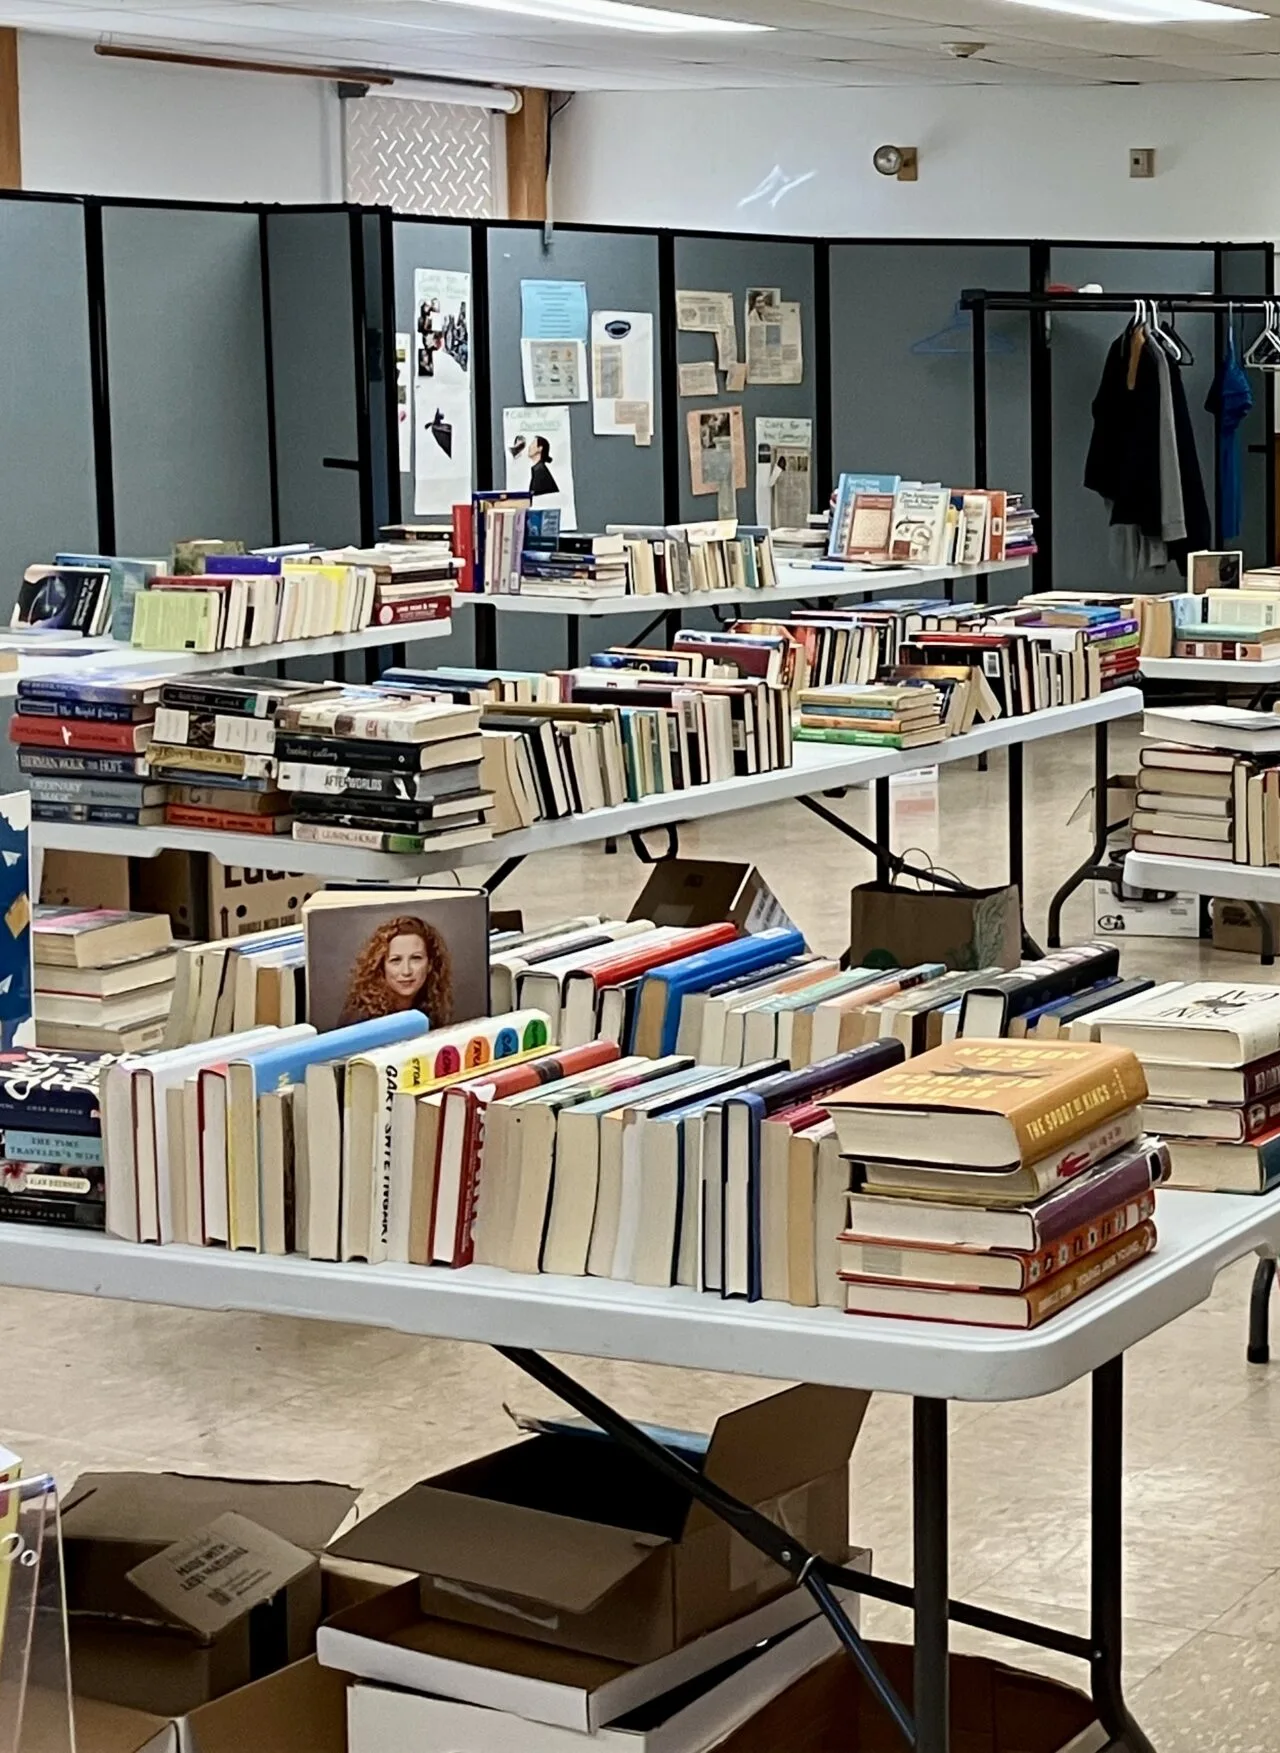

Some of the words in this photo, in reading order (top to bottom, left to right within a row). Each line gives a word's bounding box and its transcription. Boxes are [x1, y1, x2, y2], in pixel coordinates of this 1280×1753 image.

[20, 752, 58, 770] HERMAN
[99, 758, 123, 774] HOPE
[1025, 1117, 1047, 1141] THE
[1046, 1095, 1076, 1132] SPORT
[1084, 1083, 1111, 1113] KINGS
[31, 1136, 51, 1146] THE
